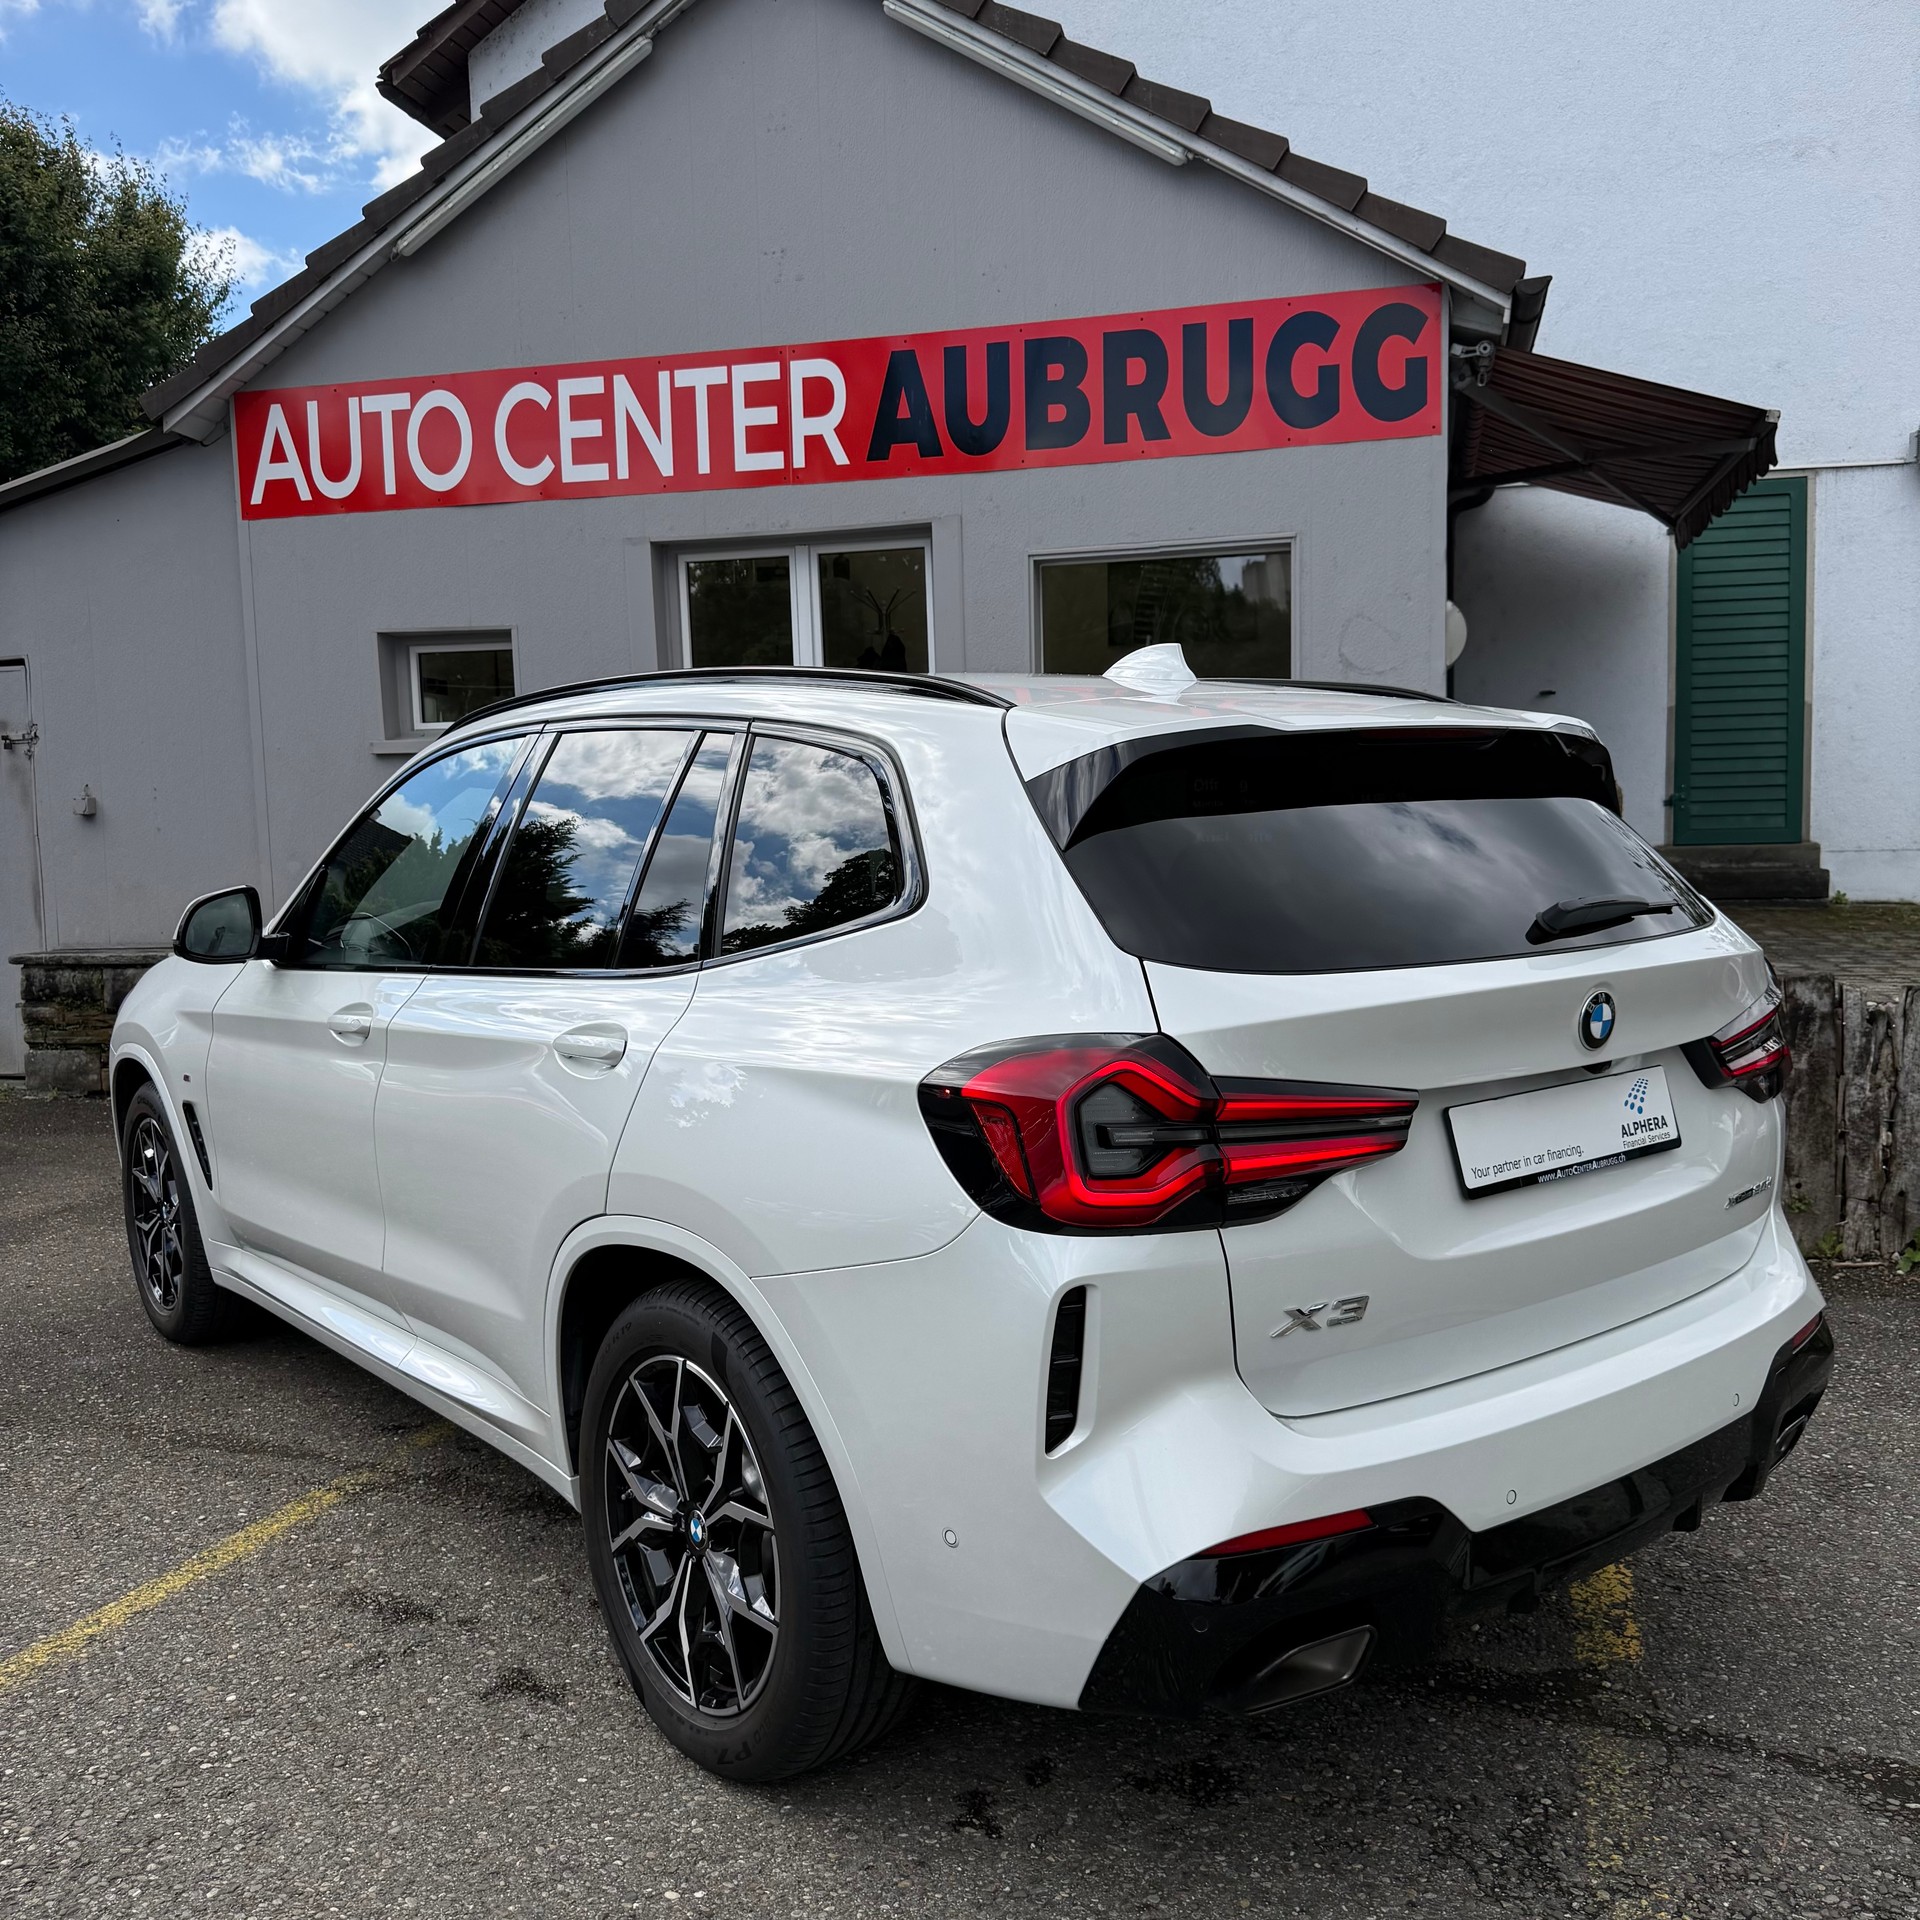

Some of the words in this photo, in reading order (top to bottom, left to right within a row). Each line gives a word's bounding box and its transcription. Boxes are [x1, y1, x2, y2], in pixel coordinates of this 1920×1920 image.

[250, 389, 473, 505] AUTO
[494, 358, 850, 487] CENTER
[866, 302, 1429, 462] AUBRUGG
[1621, 1115, 1668, 1138] ALPHERA
[1622, 1136, 1647, 1149] Financial
[1647, 1131, 1671, 1143] Services
[1471, 1166, 1490, 1179] Your
[1492, 1159, 1521, 1177] partner
[1523, 1156, 1532, 1167] in
[1533, 1153, 1545, 1164] car
[1546, 1144, 1584, 1161] financing.
[1269, 1294, 1369, 1338] X3
